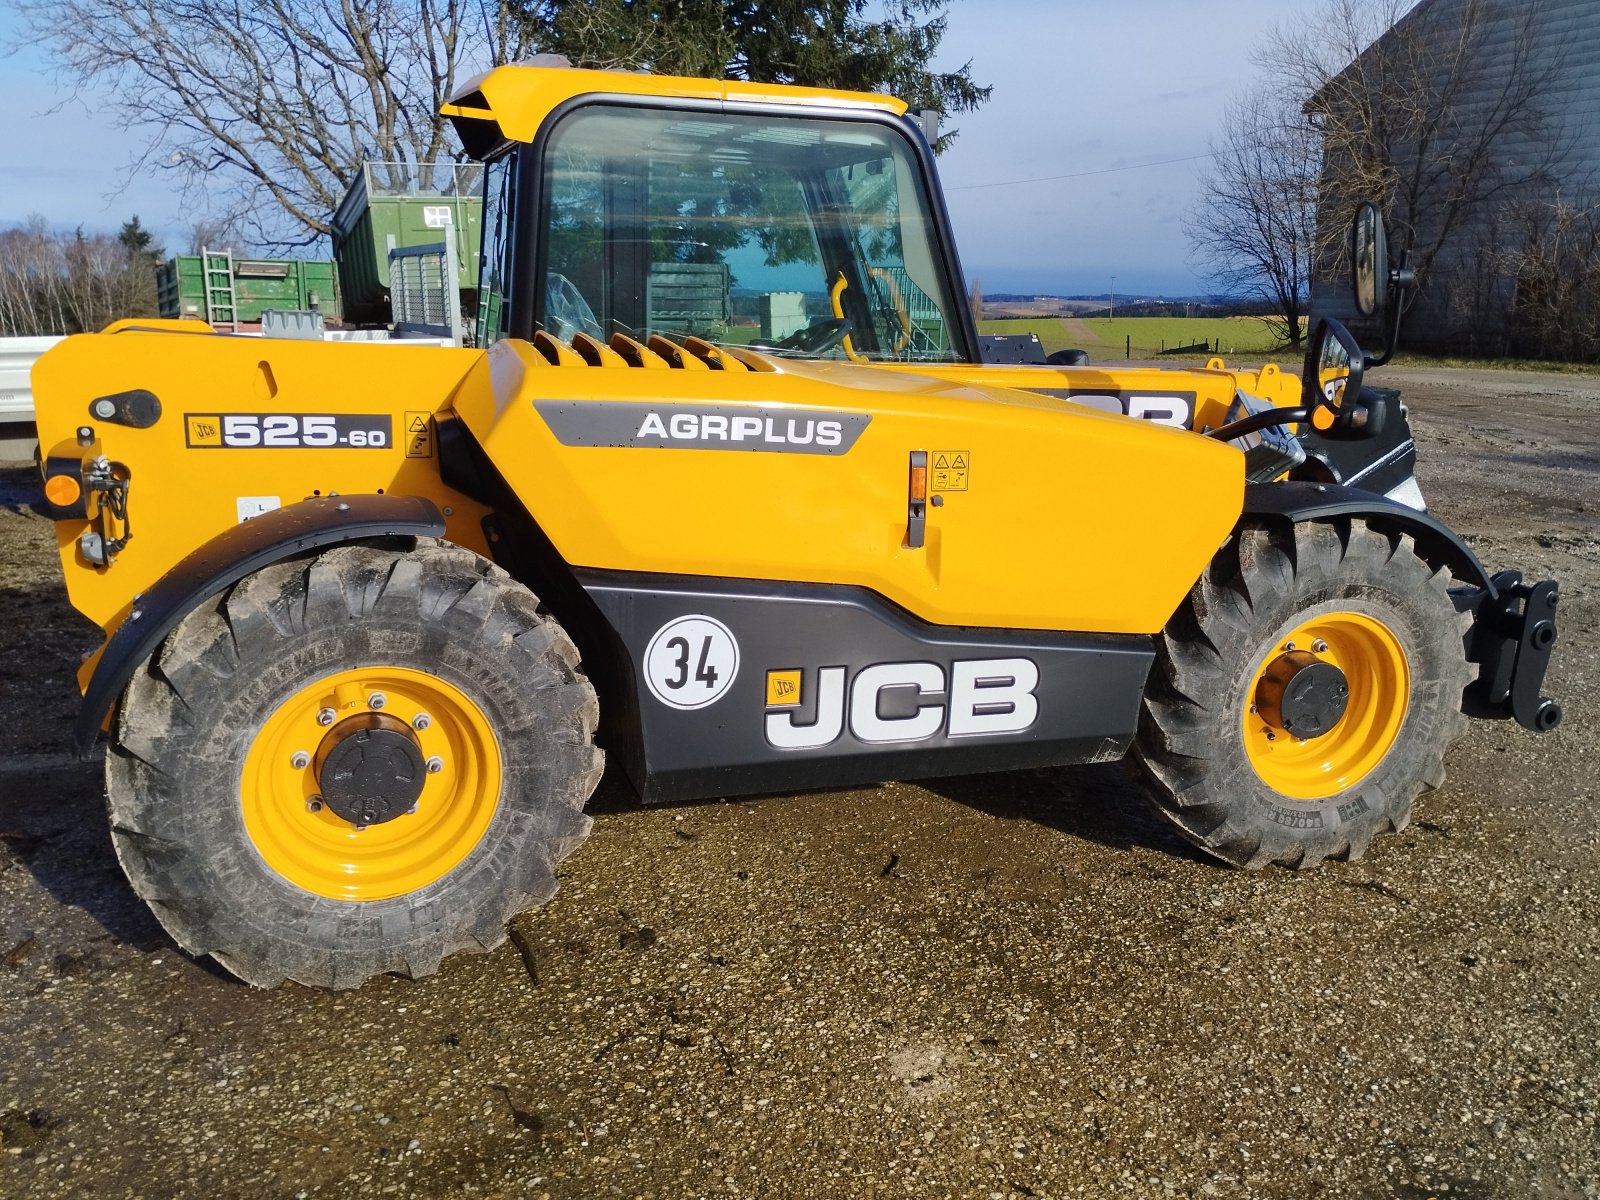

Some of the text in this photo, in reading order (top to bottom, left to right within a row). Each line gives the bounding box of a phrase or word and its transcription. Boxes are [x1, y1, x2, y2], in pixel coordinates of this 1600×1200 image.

[196, 424, 215, 438] JCB
[664, 635, 719, 691] 34
[765, 656, 1040, 751] JCB
[776, 680, 795, 696] JCB
